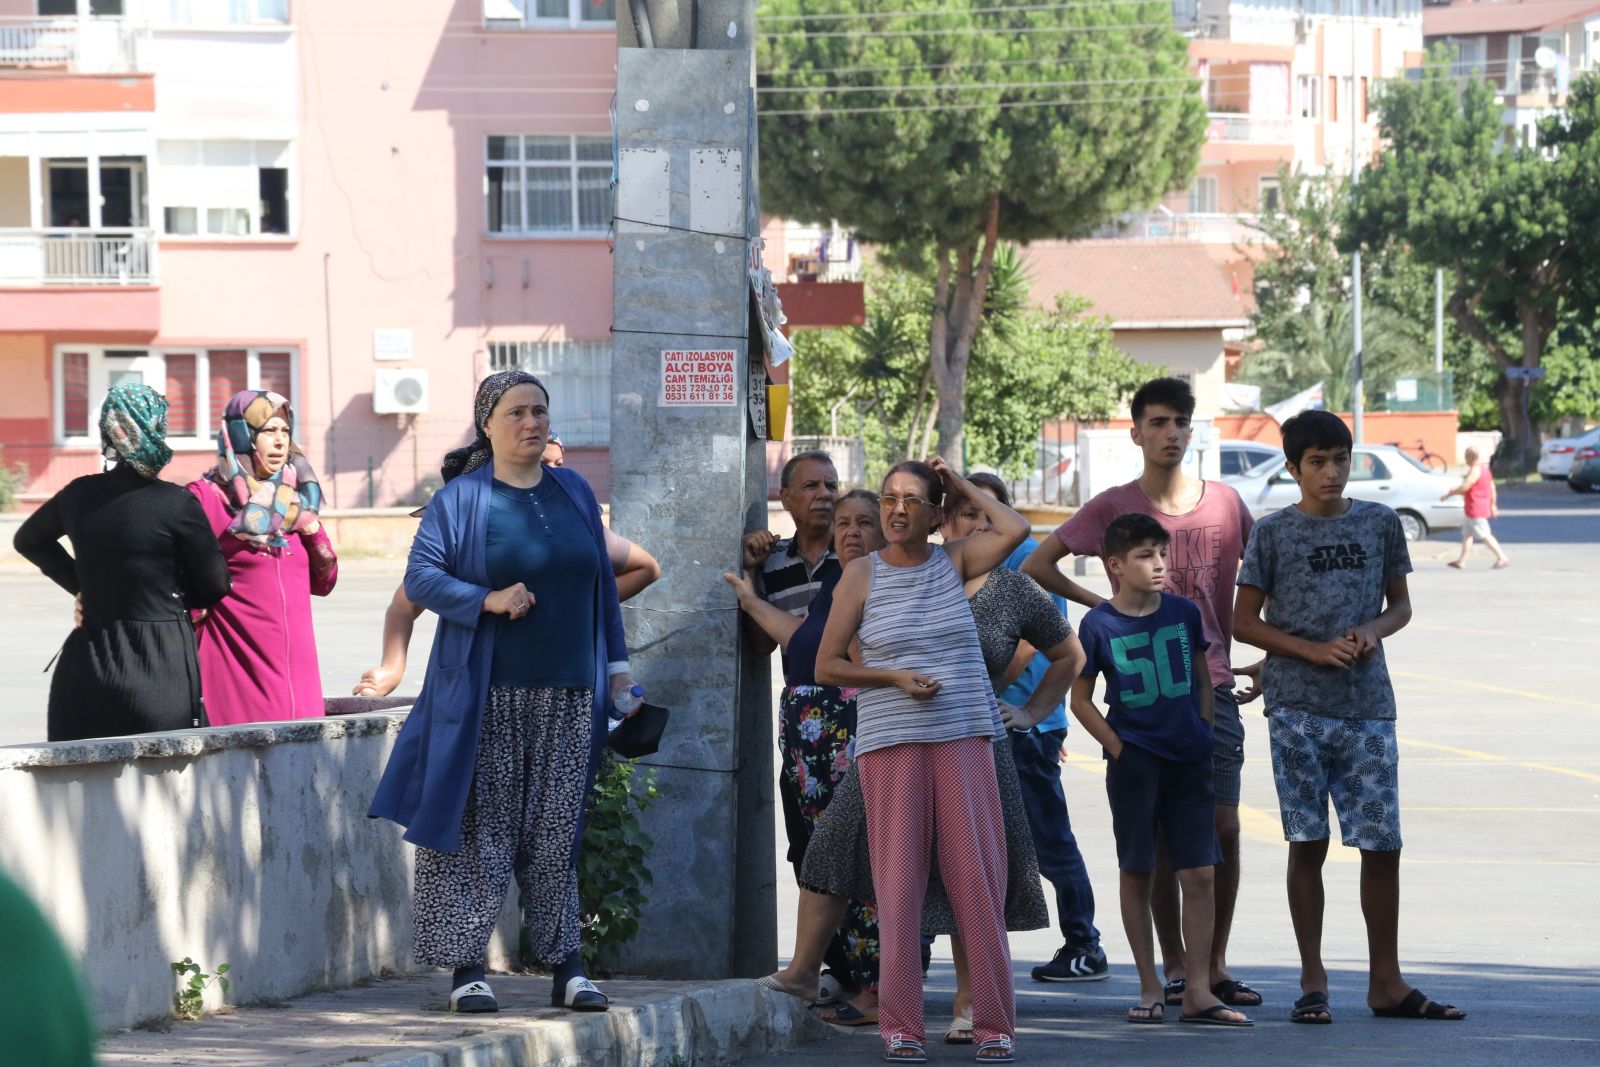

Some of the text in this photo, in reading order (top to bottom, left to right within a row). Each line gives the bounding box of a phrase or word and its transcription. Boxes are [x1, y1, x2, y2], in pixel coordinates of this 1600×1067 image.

[697, 363, 734, 372] BOYA
[665, 375, 687, 383] CAM
[665, 384, 734, 392] 0535 728 10 74
[1307, 543, 1367, 559] STAR
[1308, 556, 1368, 573] WARS
